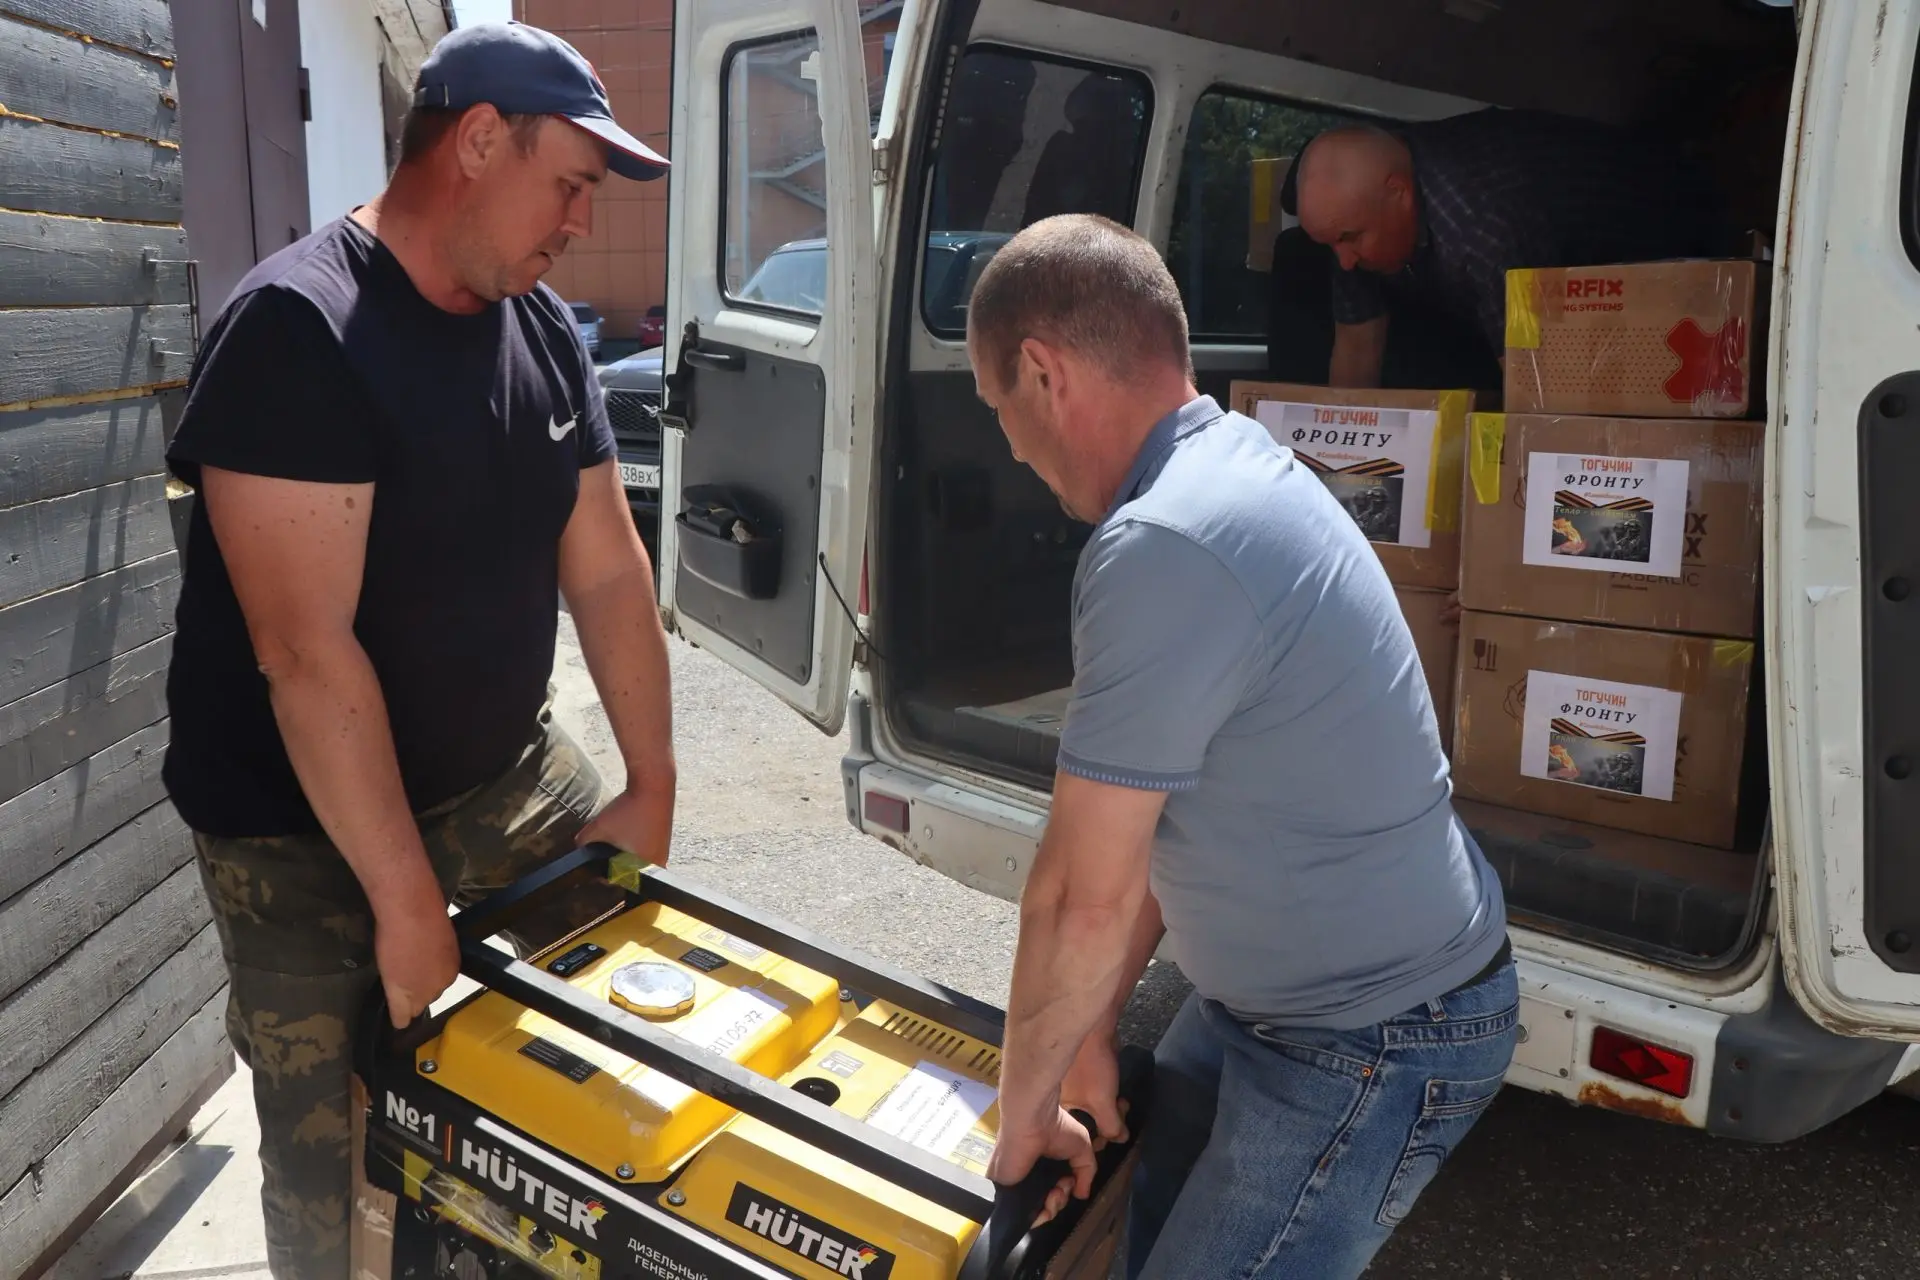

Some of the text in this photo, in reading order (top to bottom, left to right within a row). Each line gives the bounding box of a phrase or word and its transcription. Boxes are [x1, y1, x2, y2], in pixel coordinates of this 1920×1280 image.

[1579, 303, 1624, 312] SYSTEMS
[1314, 408, 1380, 427] ТОГУЧИН
[1291, 428, 1393, 448] ФРОНТУ
[1580, 458, 1633, 473] ТОГУЧИН
[1564, 474, 1645, 489] ФРОНТУ
[1576, 689, 1627, 708] ТОГУЧИН
[1560, 703, 1637, 724] ФРОНТУ
[461, 1138, 600, 1240] HÜTER
[743, 1201, 868, 1280] HÜTER
[627, 1236, 709, 1280] ДИЗЕЛЬНЫЙ
